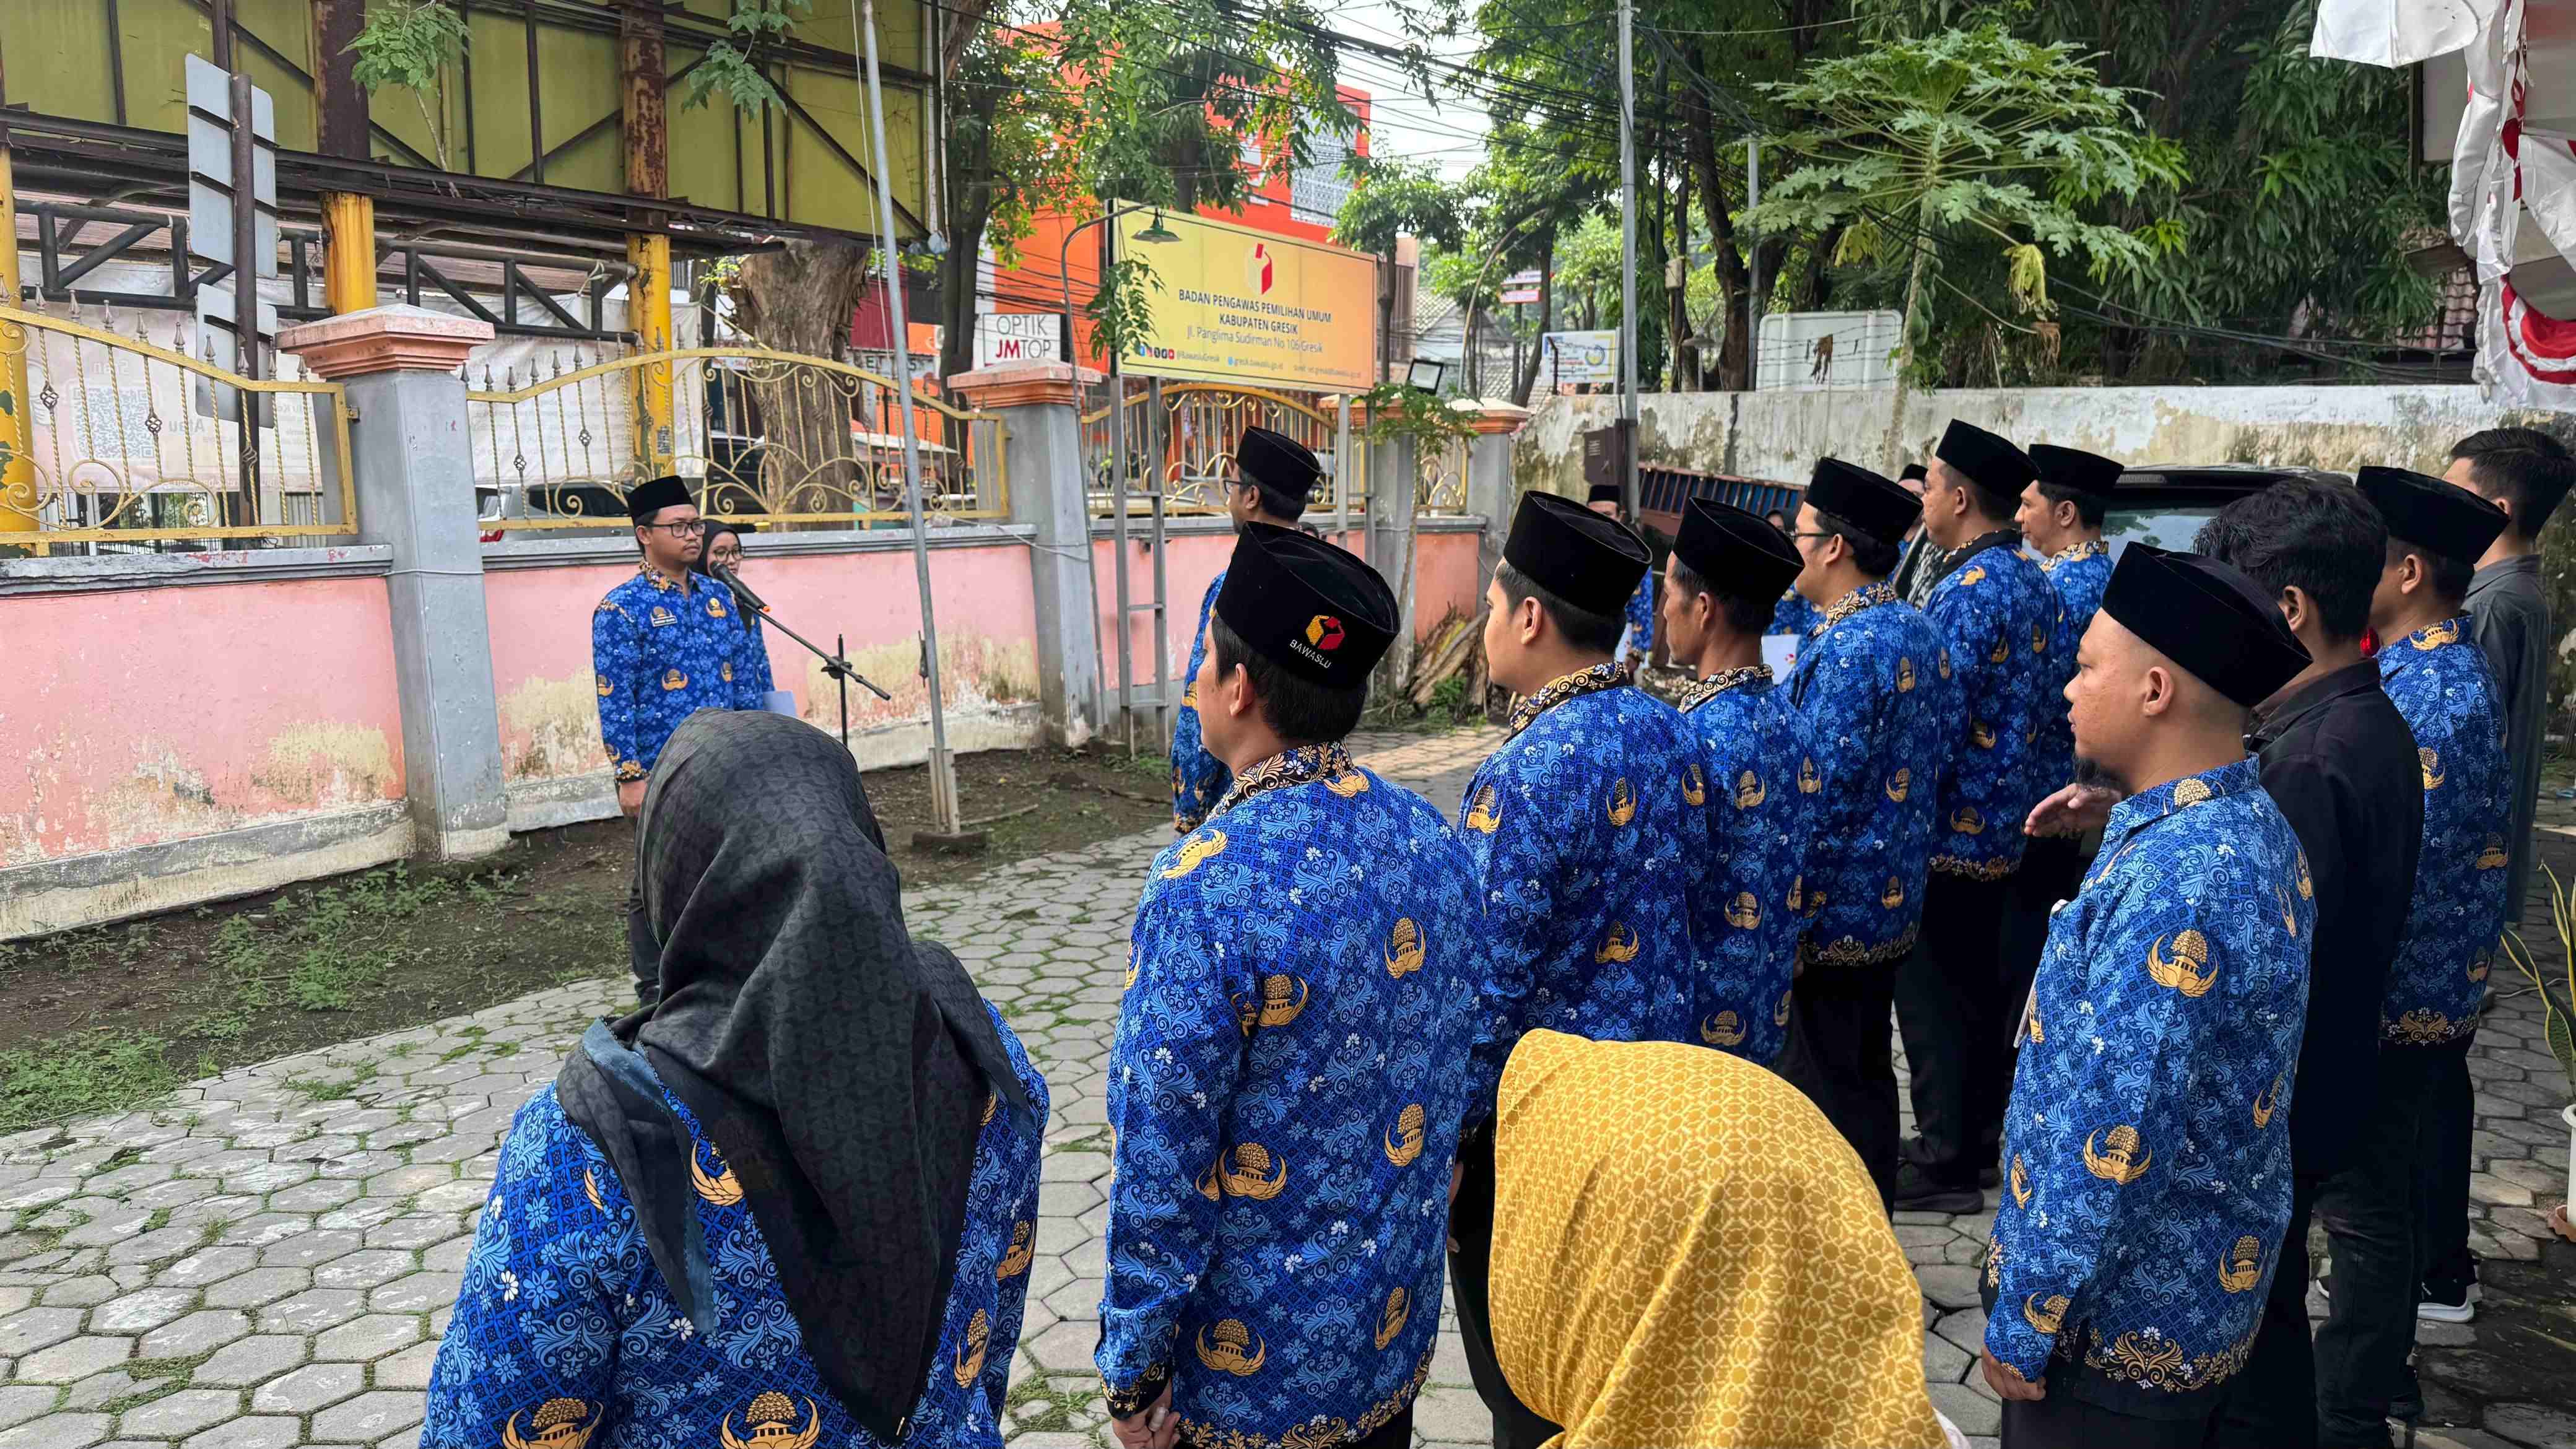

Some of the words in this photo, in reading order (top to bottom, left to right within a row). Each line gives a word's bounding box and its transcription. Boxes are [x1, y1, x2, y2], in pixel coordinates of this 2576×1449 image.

[1178, 289, 1210, 305] BADAN
[1213, 294, 1259, 312] PENGAWAS
[1261, 302, 1304, 319] PEMILIHAN
[1307, 309, 1331, 323] UMUM
[996, 315, 1048, 335] OPTIK
[1219, 313, 1269, 330] KABUPATEN
[1271, 321, 1299, 334] GRESIK
[996, 339, 1051, 359] JMTOP
[1196, 326, 1234, 344] Panglima
[1235, 331, 1272, 347] Sudirman
[1301, 340, 1323, 352] Gresik
[1289, 639, 1331, 669] BAWASLU
